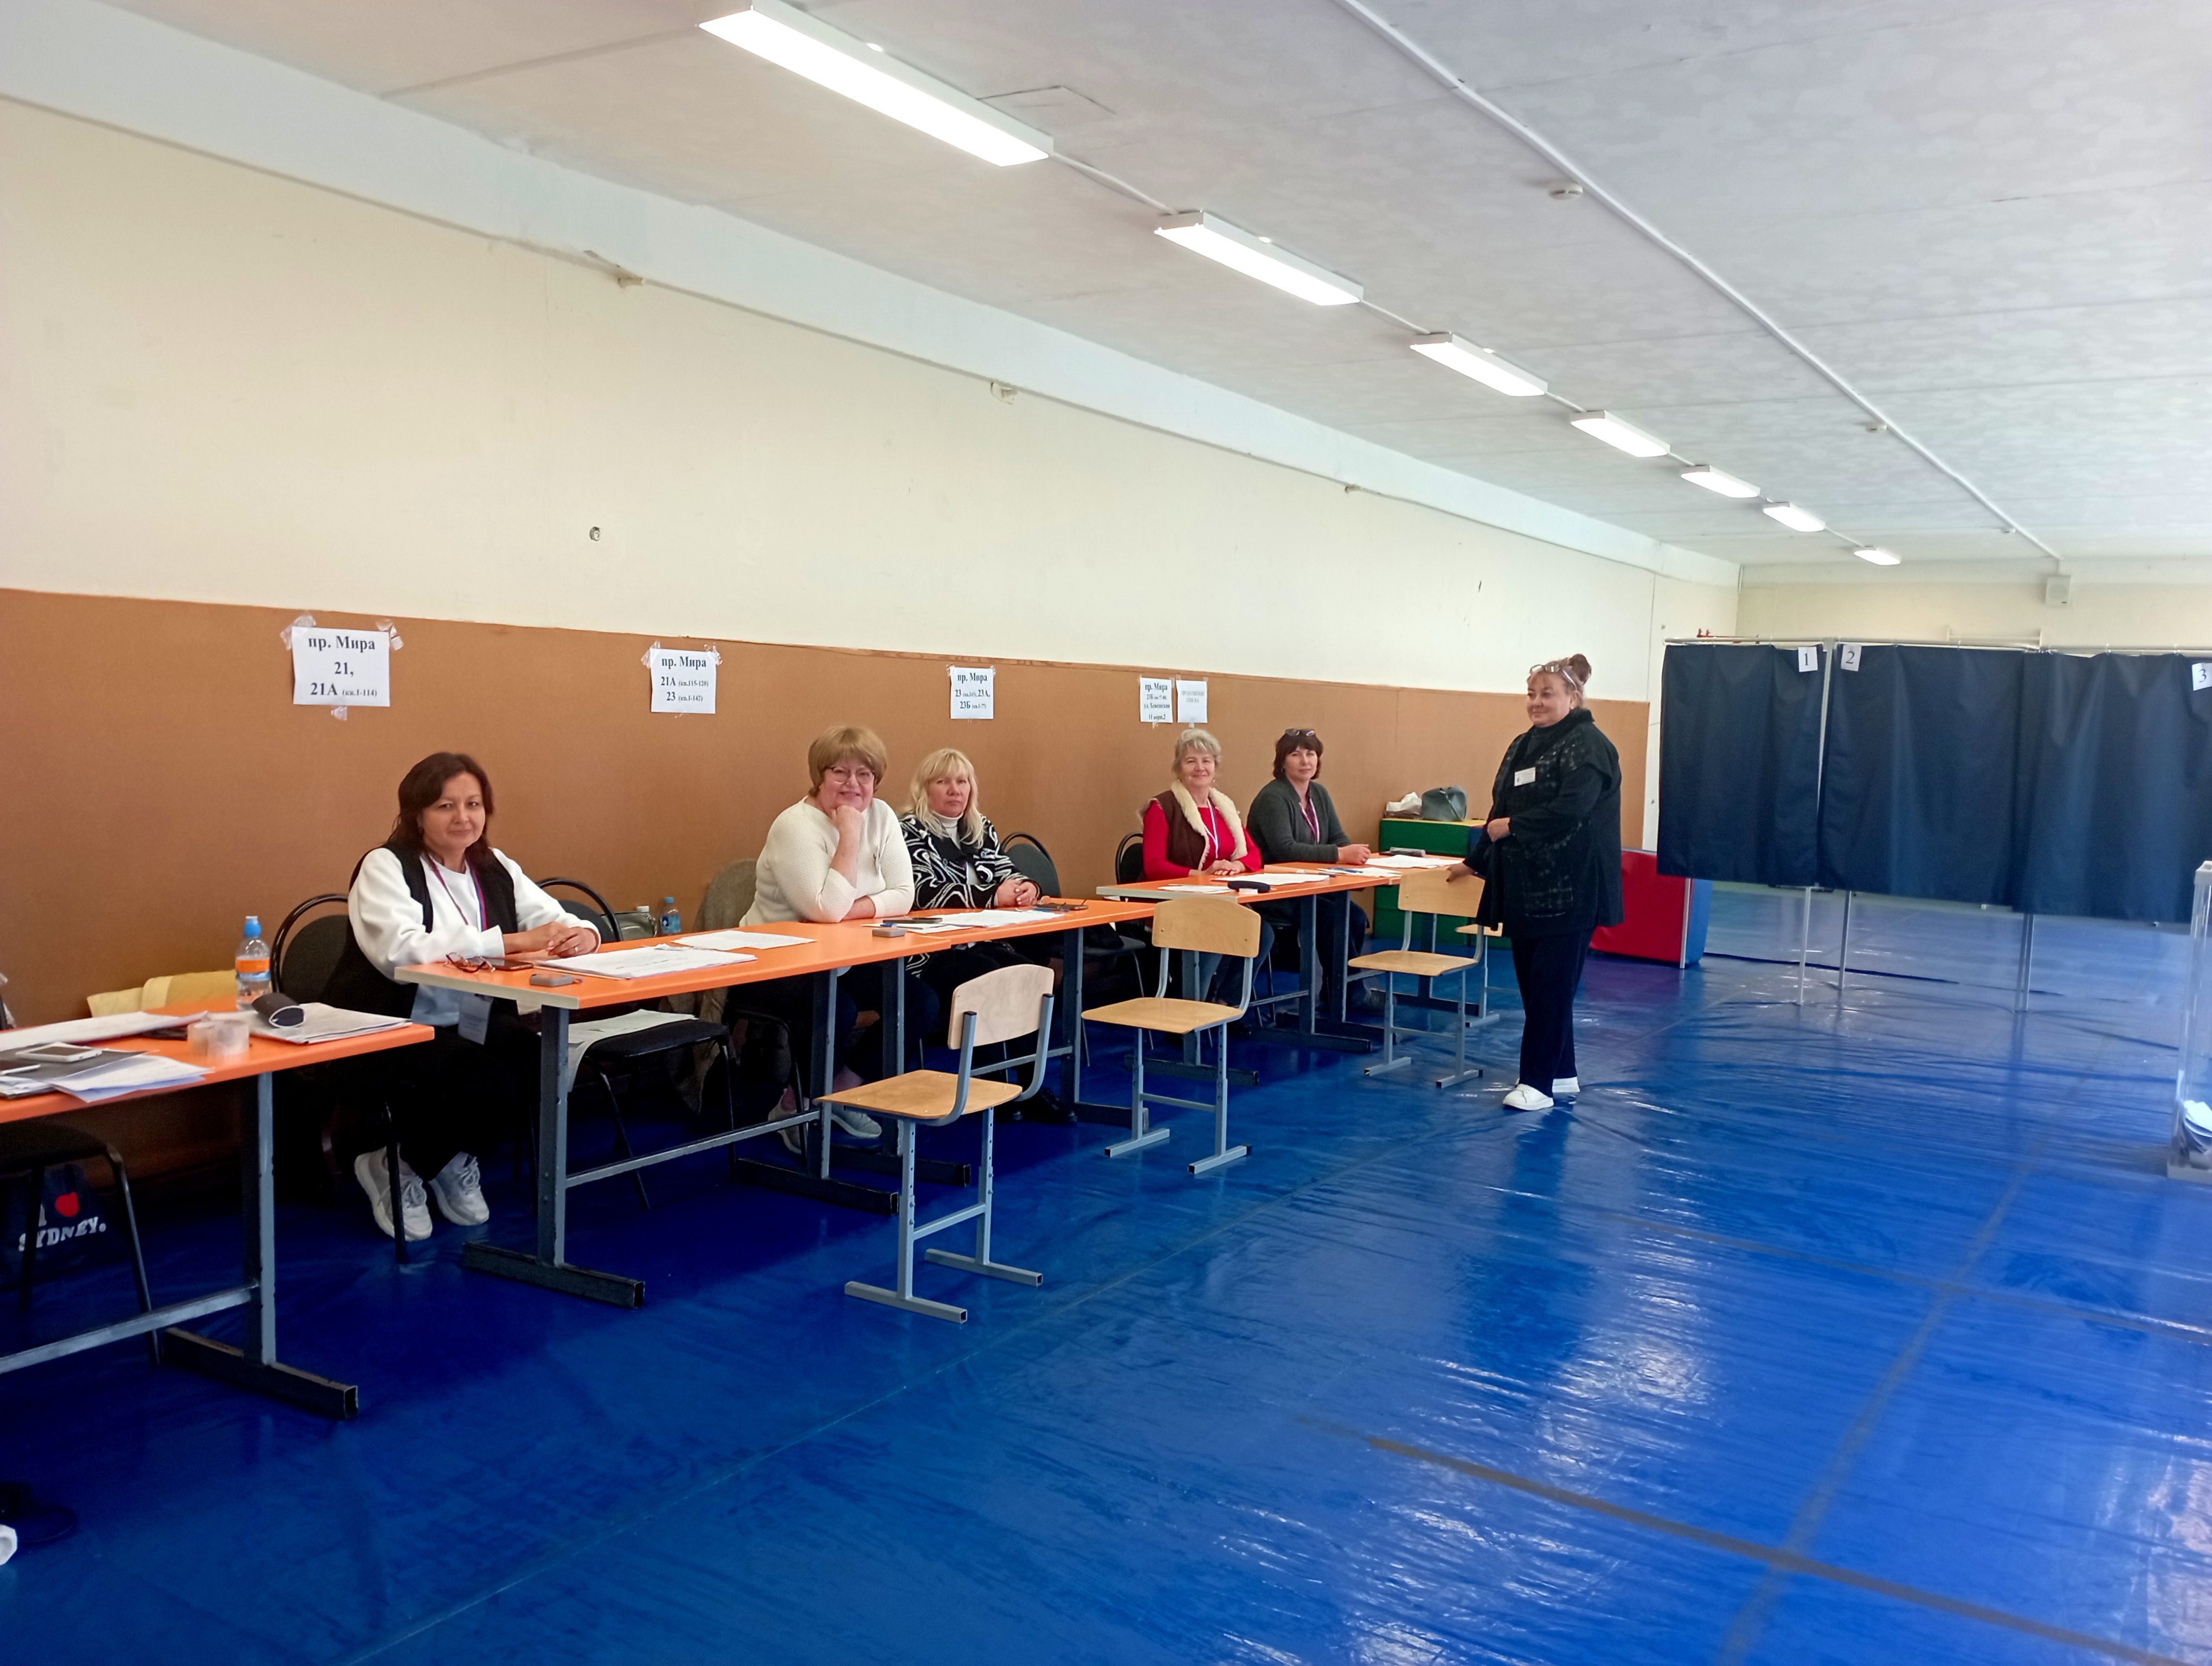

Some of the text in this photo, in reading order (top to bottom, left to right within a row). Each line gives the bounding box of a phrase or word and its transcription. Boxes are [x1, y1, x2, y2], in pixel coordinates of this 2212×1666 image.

[308, 636, 375, 653] пр. Мира
[661, 656, 706, 670] пр. Мира
[1804, 652, 1809, 666] 1
[1845, 651, 1855, 664] 2
[334, 662, 354, 677] 21,
[2198, 668, 2207, 683] 3
[660, 676, 676, 686] 21А
[957, 672, 988, 684] пр. Мира
[311, 682, 377, 697] 21А (кв.1-114)
[955, 689, 962, 697] 23
[1144, 683, 1168, 693] пр. Мира
[666, 691, 676, 701] 23
[960, 701, 970, 709] 23Б
